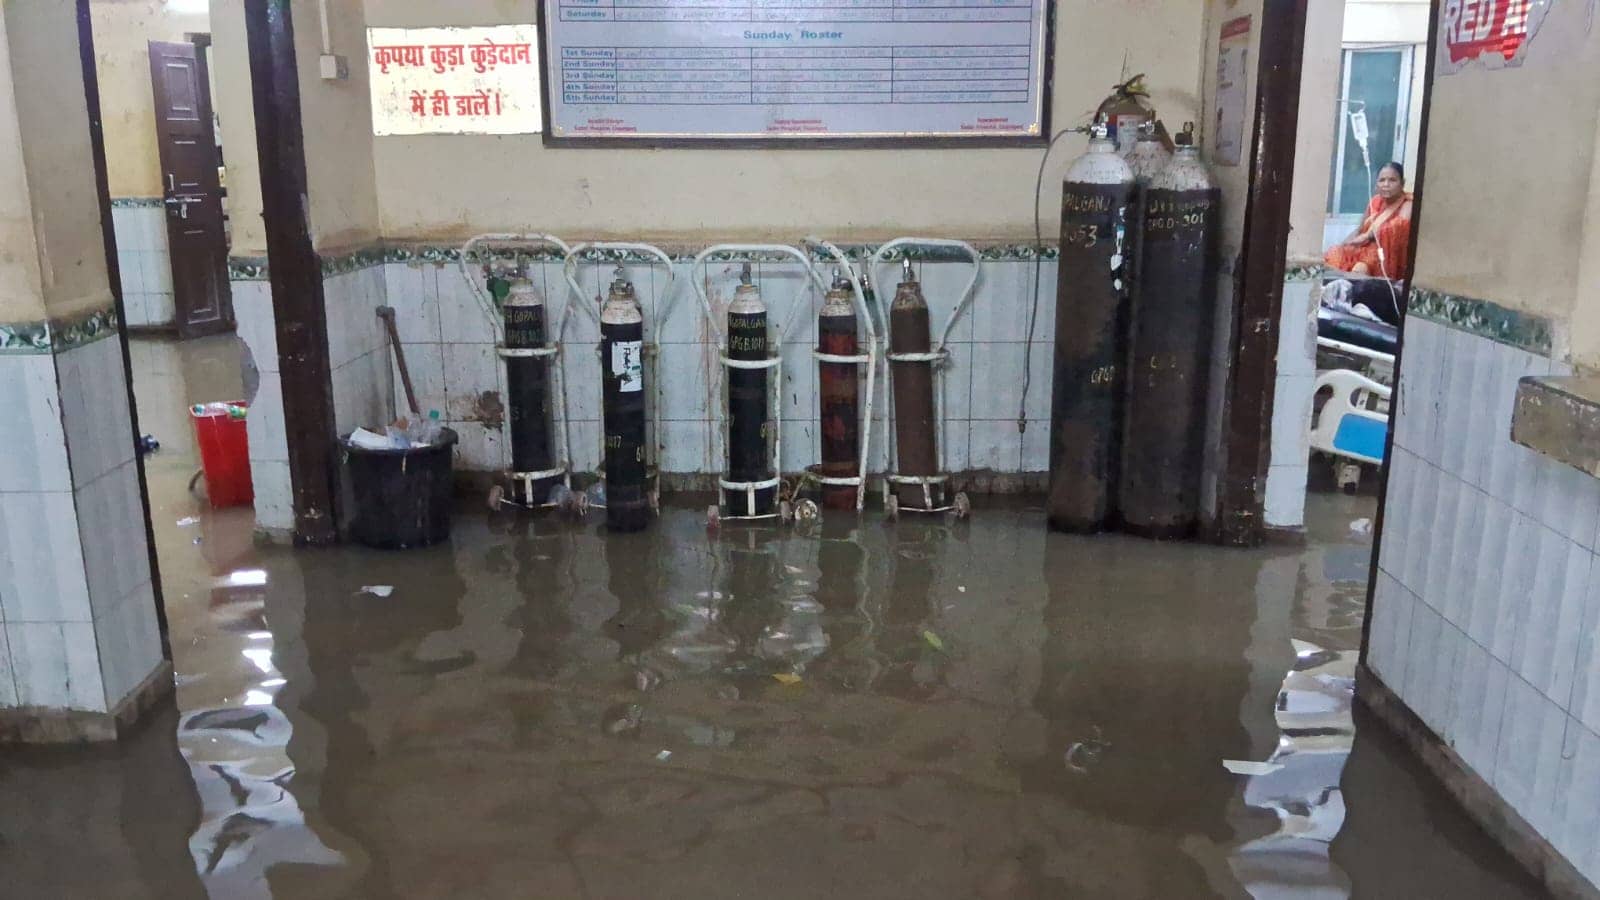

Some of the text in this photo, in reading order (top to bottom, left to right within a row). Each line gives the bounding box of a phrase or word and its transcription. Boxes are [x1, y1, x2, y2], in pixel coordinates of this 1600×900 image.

[567, 10, 606, 18] Saturday
[743, 30, 843, 40] Sunday Roster
[372, 45, 425, 74] कृपया
[409, 89, 428, 116] में
[429, 89, 450, 116] ही
